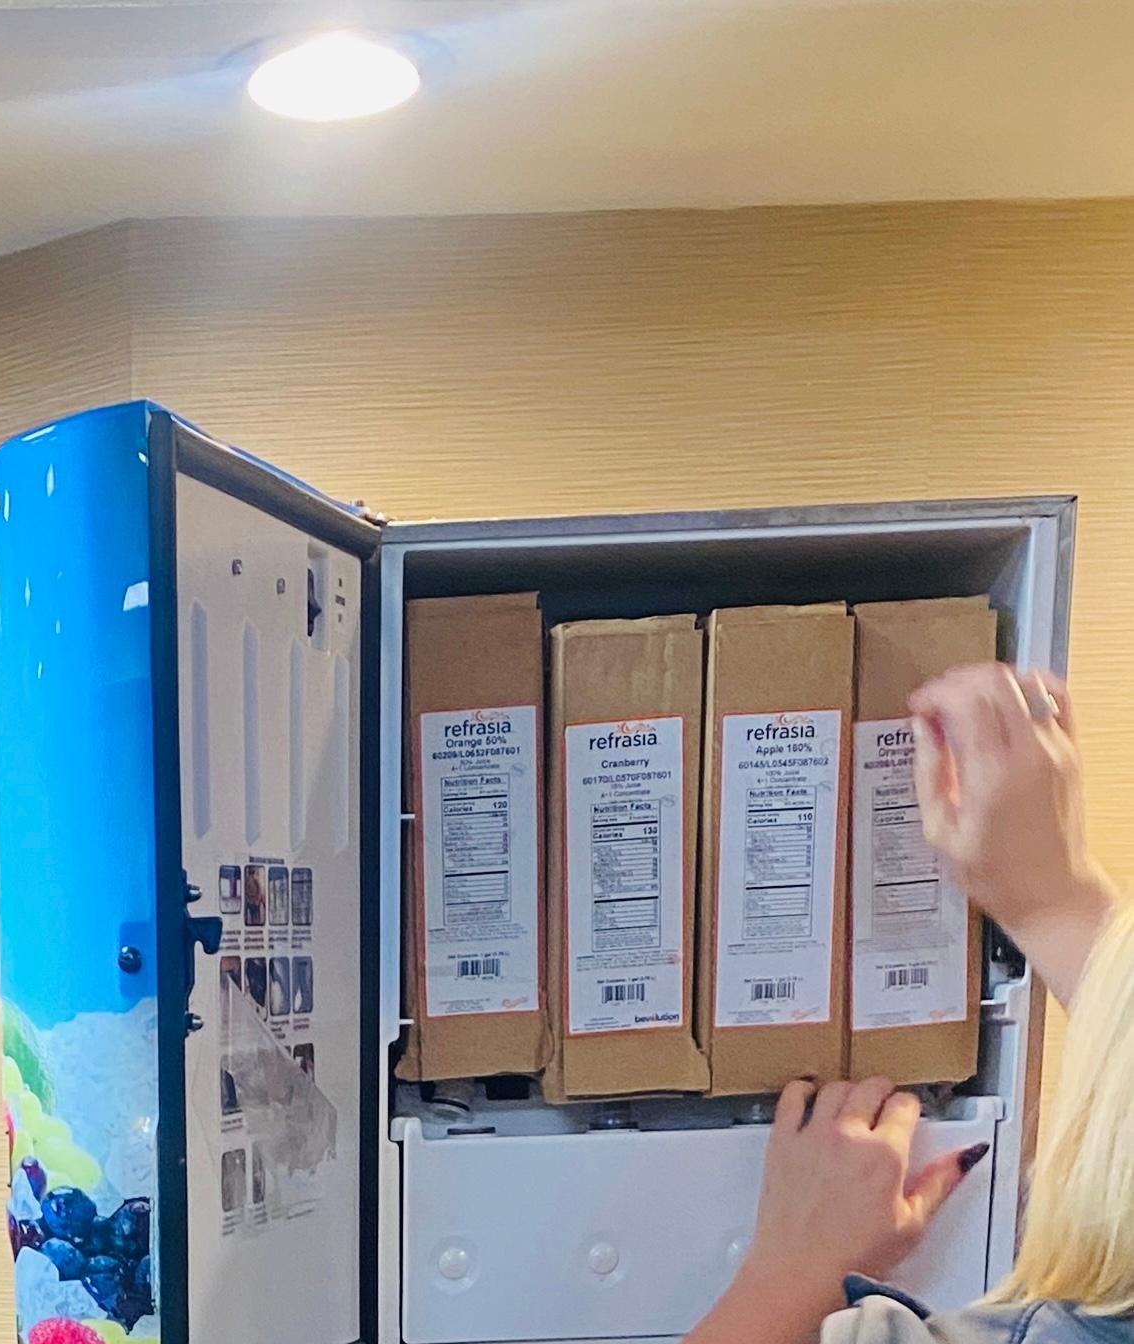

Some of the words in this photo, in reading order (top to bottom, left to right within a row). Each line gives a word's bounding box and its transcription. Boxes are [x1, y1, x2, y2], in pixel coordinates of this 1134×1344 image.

[444, 719, 511, 738] refrasia
[747, 723, 815, 741] refrasia
[446, 738, 482, 749] Orange
[486, 735, 507, 745] 50%
[589, 732, 657, 750] refrasia
[876, 729, 915, 747] refr
[755, 745, 784, 757] Apple
[601, 759, 650, 769] Cranberry
[797, 813, 813, 821] 110
